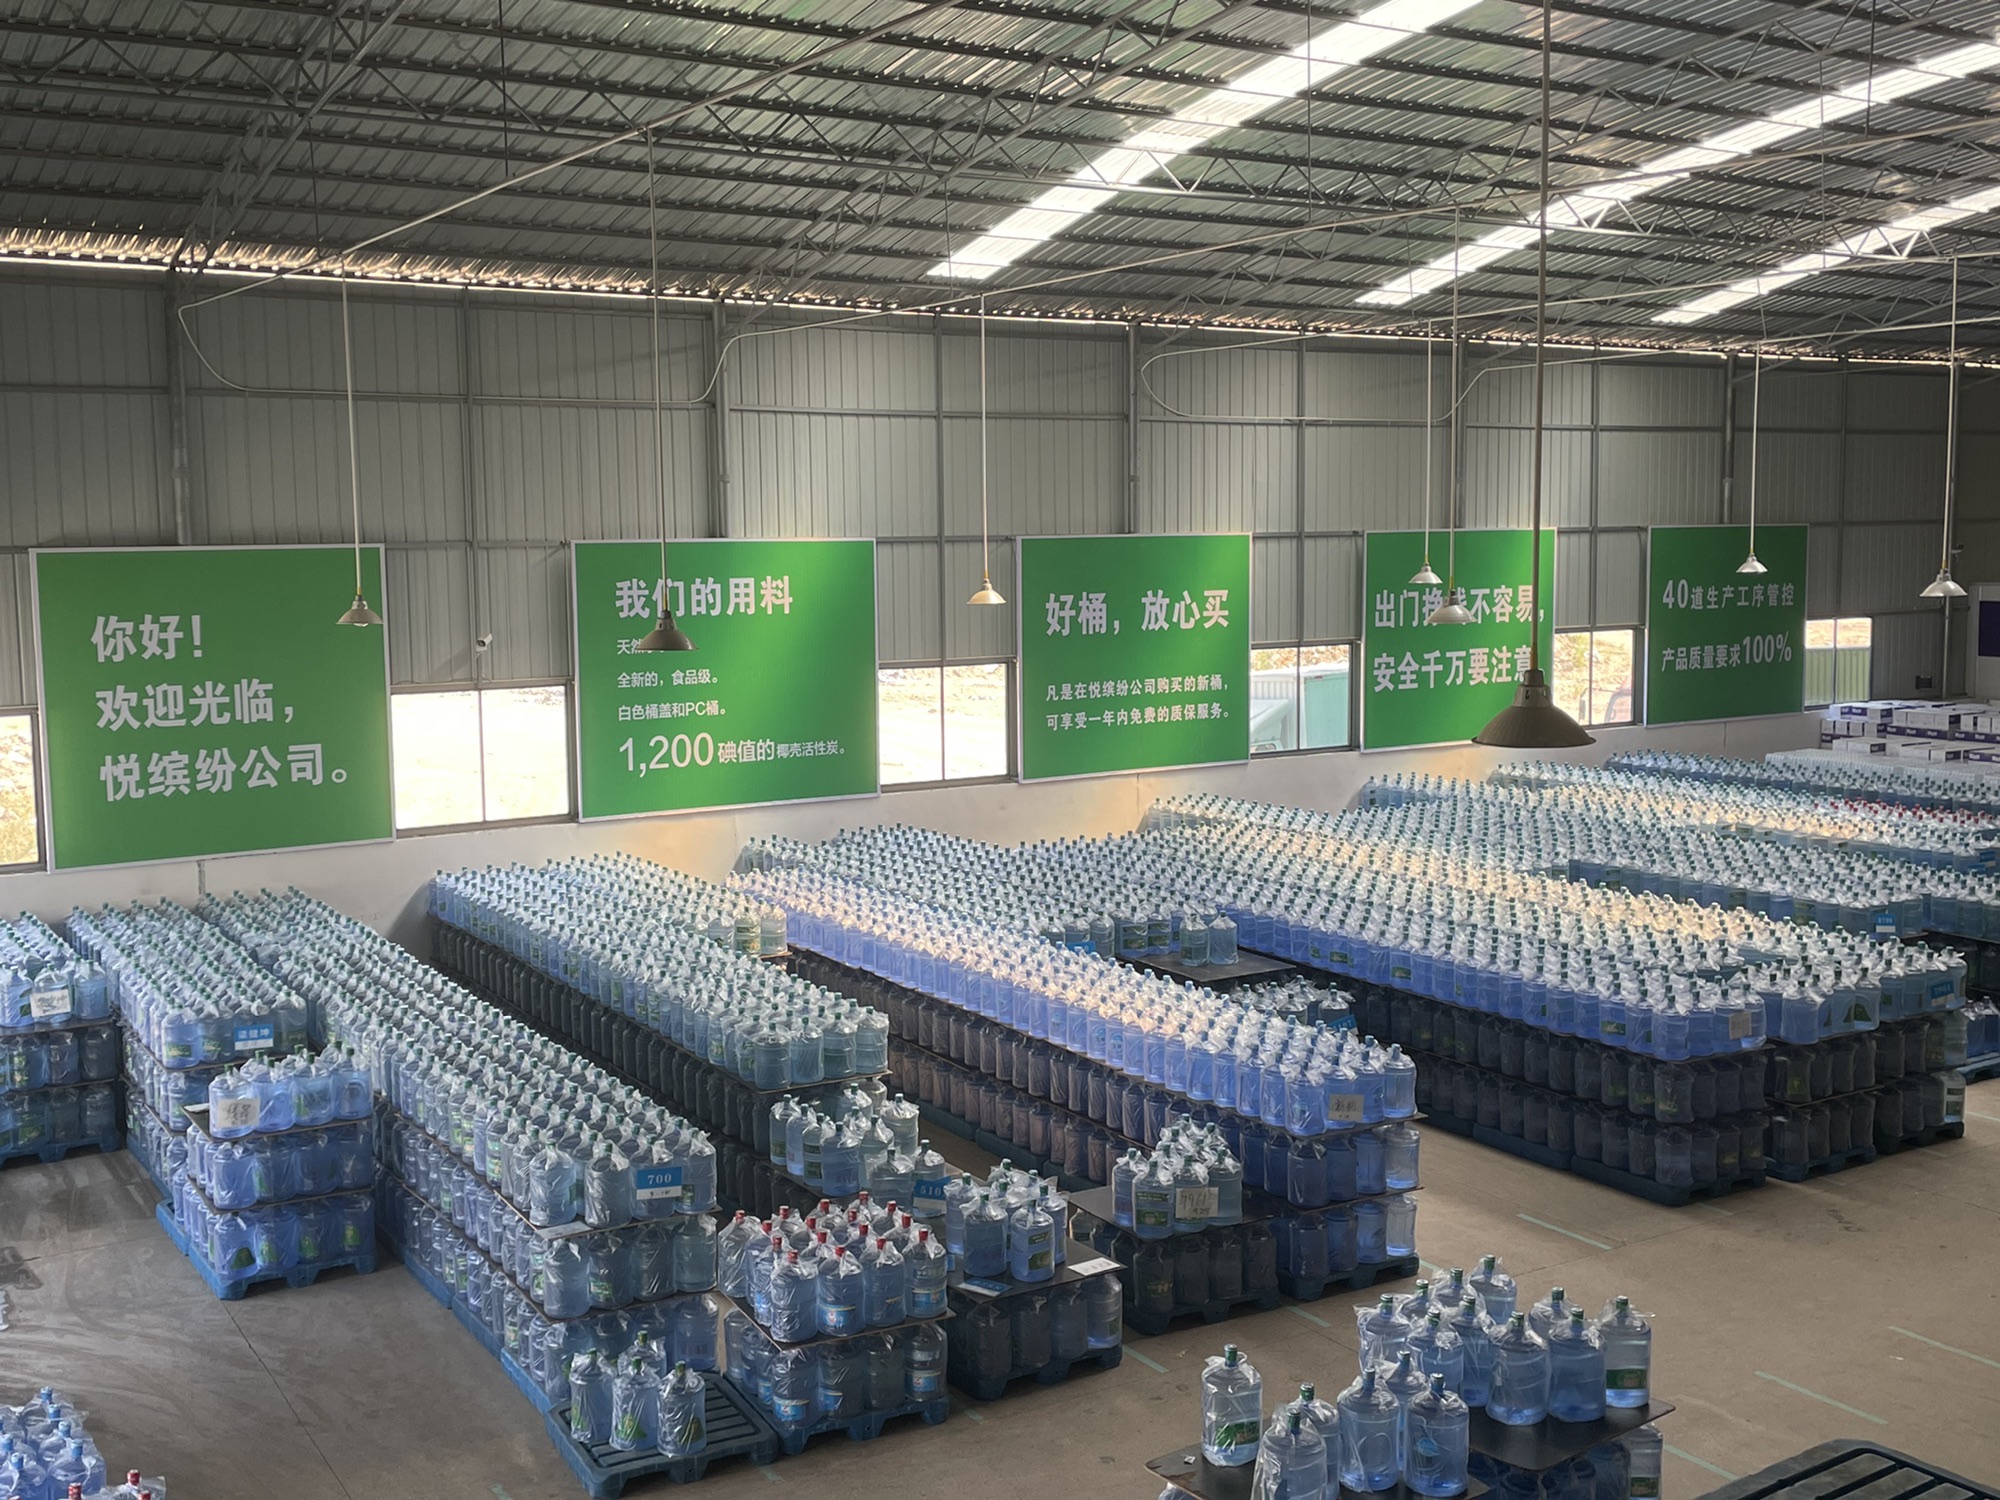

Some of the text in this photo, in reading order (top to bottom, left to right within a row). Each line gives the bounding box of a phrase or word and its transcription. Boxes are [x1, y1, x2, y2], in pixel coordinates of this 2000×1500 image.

[615, 575, 793, 619] 我们的用料
[1662, 579, 1794, 610] 40道生产工序管控
[91, 614, 202, 662] 你好！
[1662, 631, 1792, 672] 产品质量要求100%
[95, 678, 294, 731] 欢迎光临，
[1046, 702, 1229, 731] 可享受一年内免费的质保服务。
[100, 743, 347, 802] 悦缤纷公司。
[648, 1173, 672, 1185] 700
